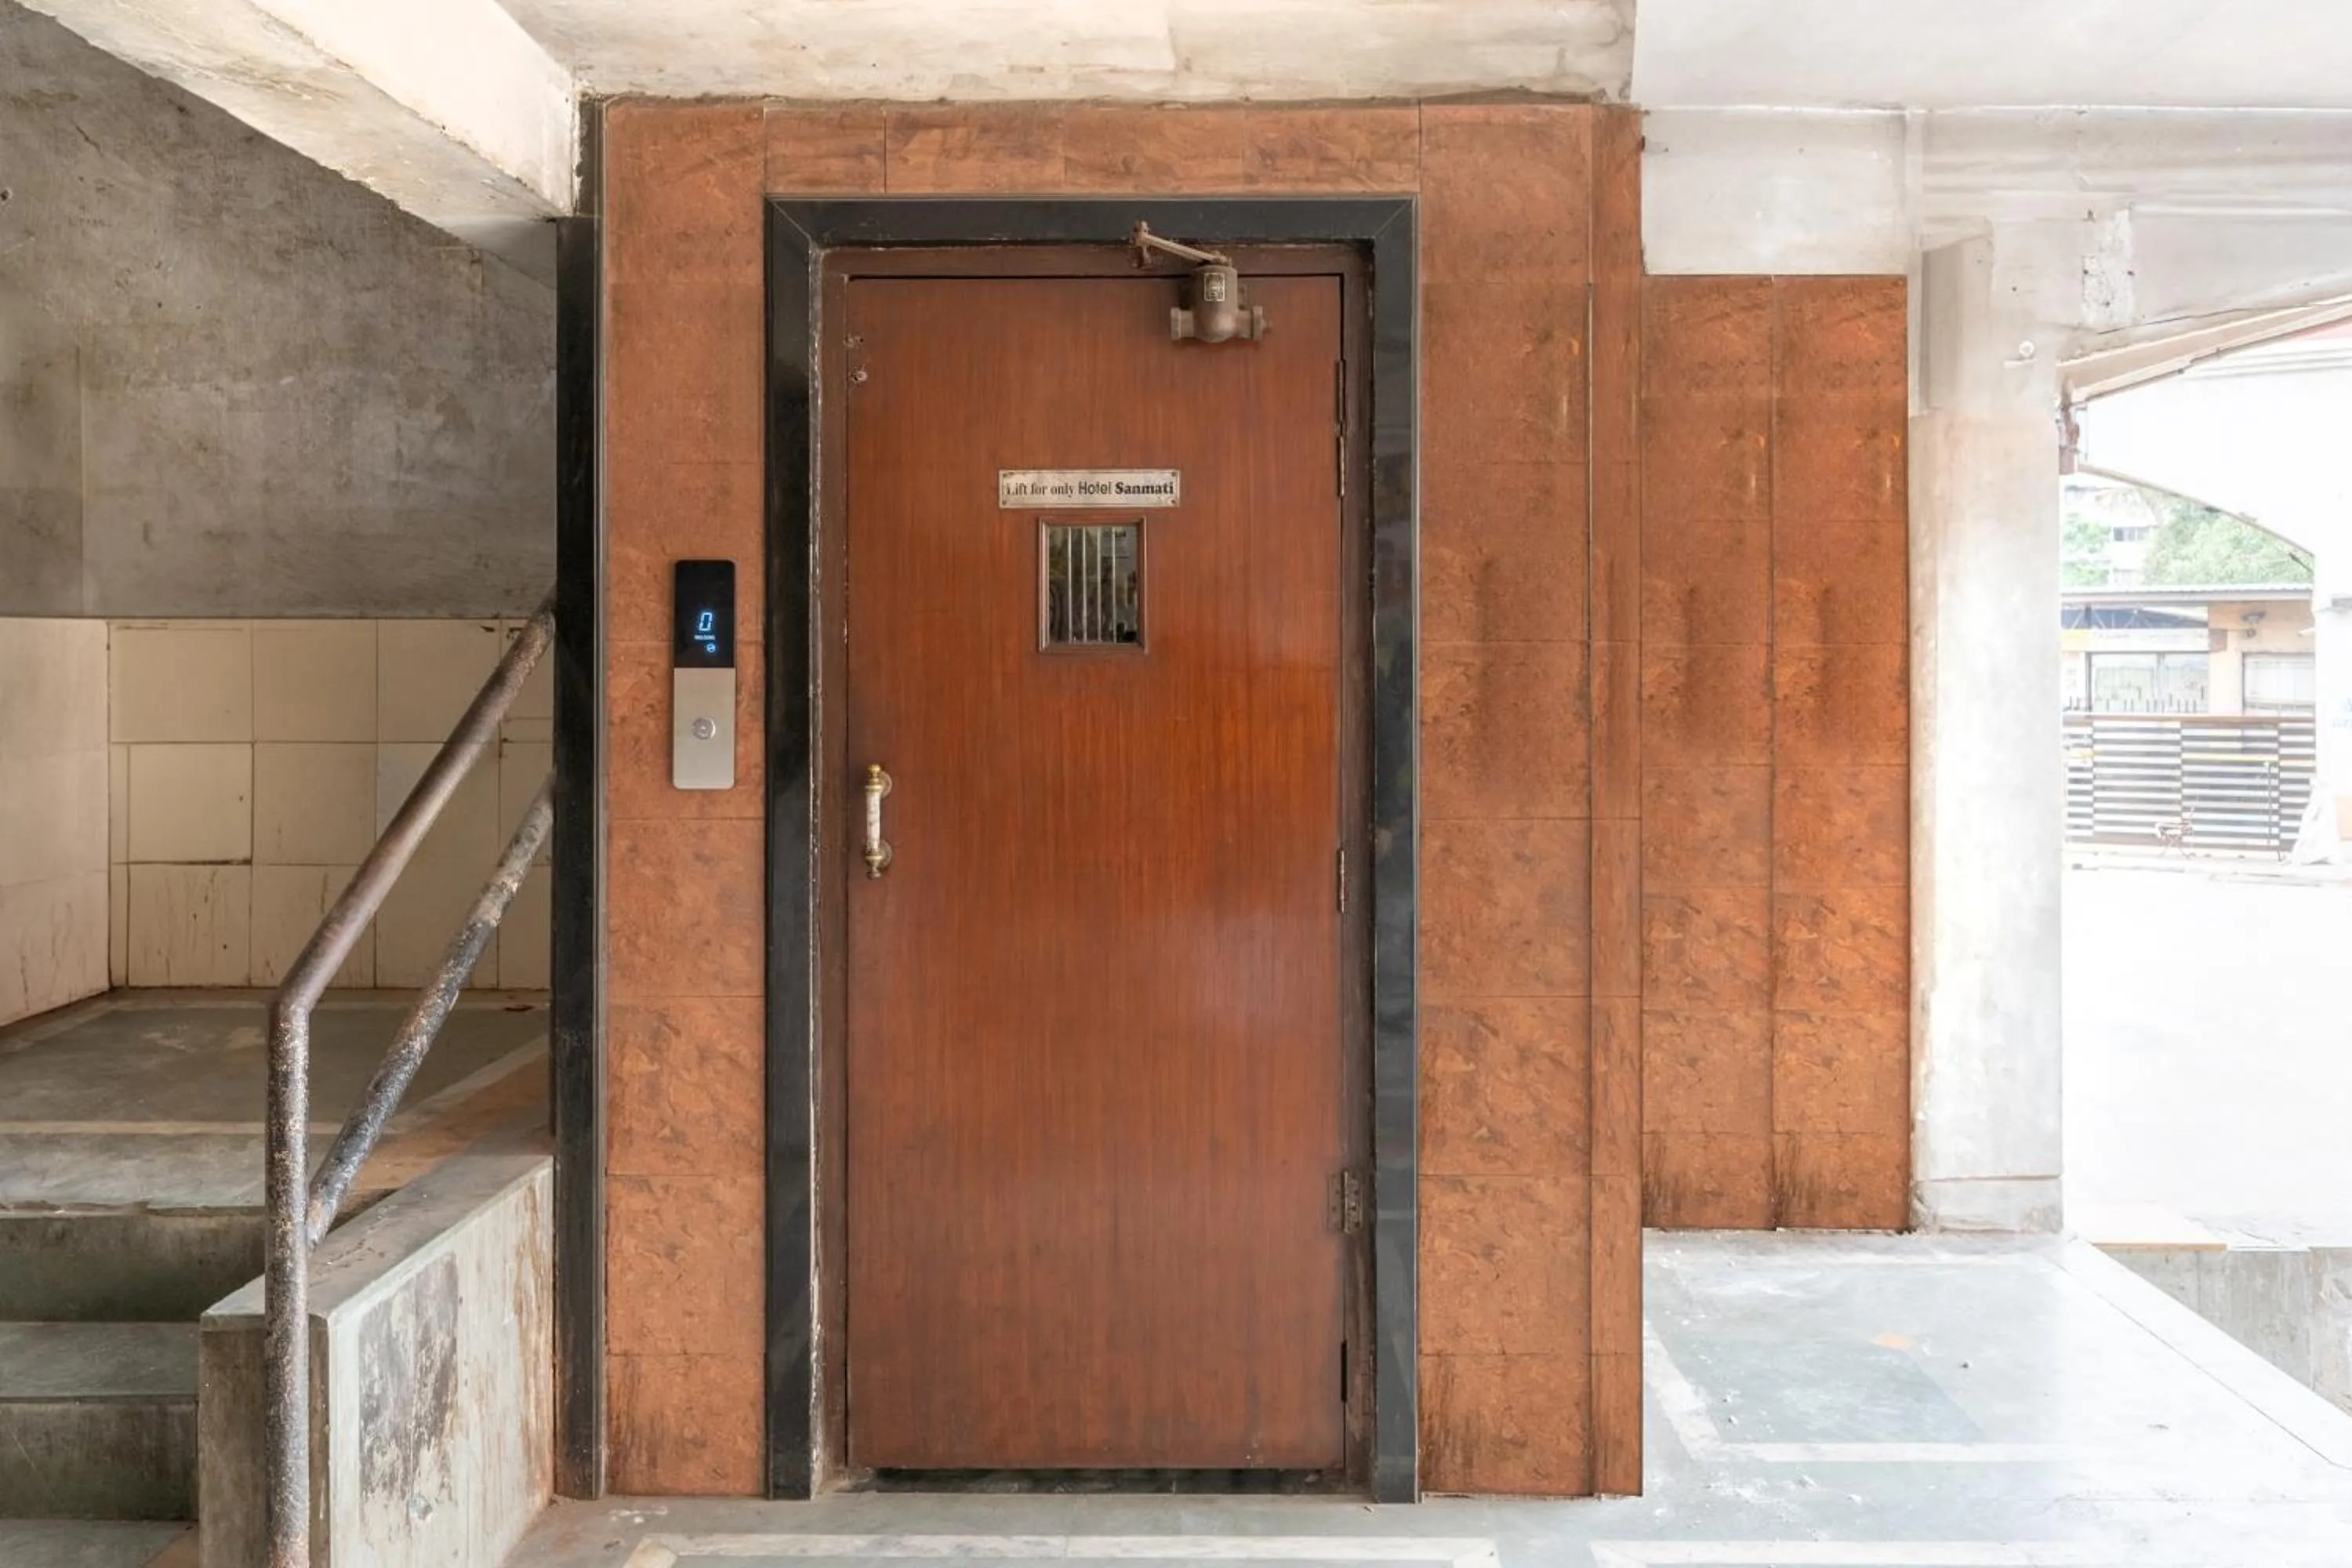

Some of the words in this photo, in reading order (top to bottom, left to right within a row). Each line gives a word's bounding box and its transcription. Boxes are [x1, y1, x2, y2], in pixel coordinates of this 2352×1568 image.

[1007, 483, 1028, 495] Lift
[1031, 483, 1047, 495] for
[1051, 483, 1074, 498] only
[1078, 481, 1112, 495] Hotel
[1115, 481, 1174, 495] Sanmati
[699, 612, 713, 631] 0
